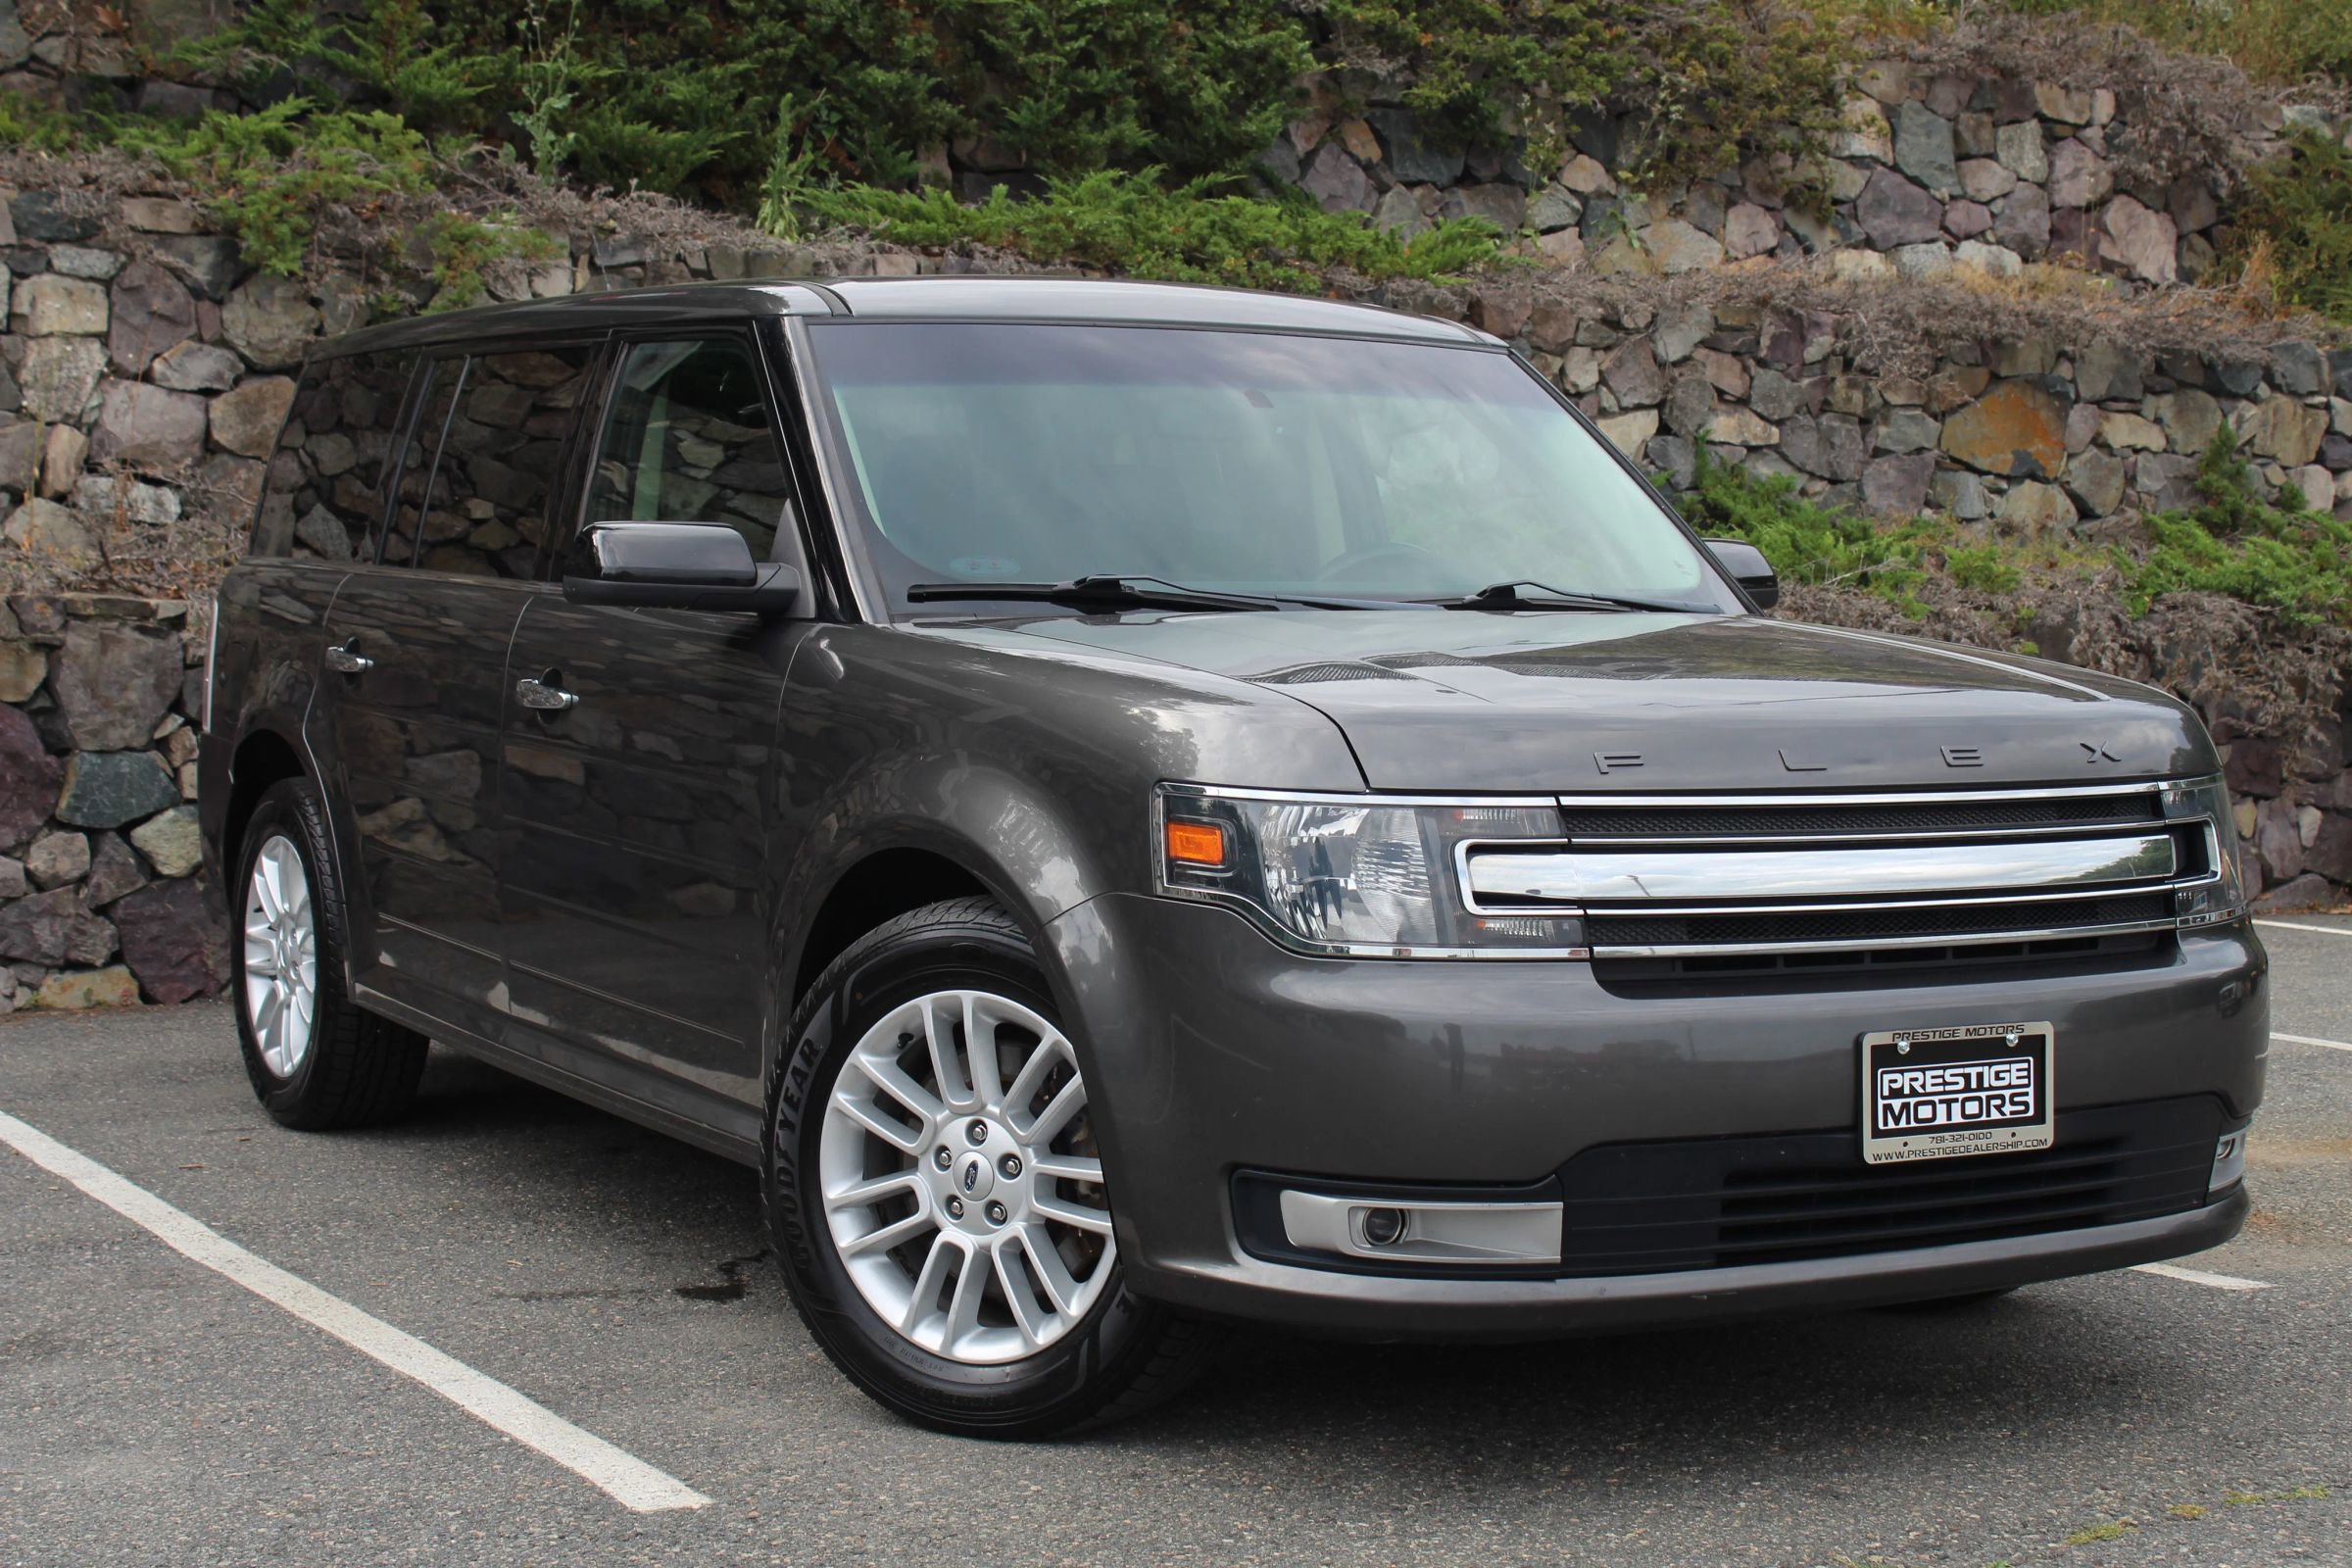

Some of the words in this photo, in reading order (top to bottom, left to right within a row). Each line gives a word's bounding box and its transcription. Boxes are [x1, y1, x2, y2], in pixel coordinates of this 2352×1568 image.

[1593, 741, 2122, 774] FLEX
[1892, 1028, 1960, 1042] PRESTIGE
[1965, 1024, 2025, 1037] MOTORS
[1883, 1062, 2029, 1096] PRESTIGE
[1883, 1092, 2030, 1127] MOTORS
[1872, 1139, 2047, 1162] WWW.PRESTIGEDEALERSHIP.COM
[1929, 1132, 1992, 1144] 781-321-0100
